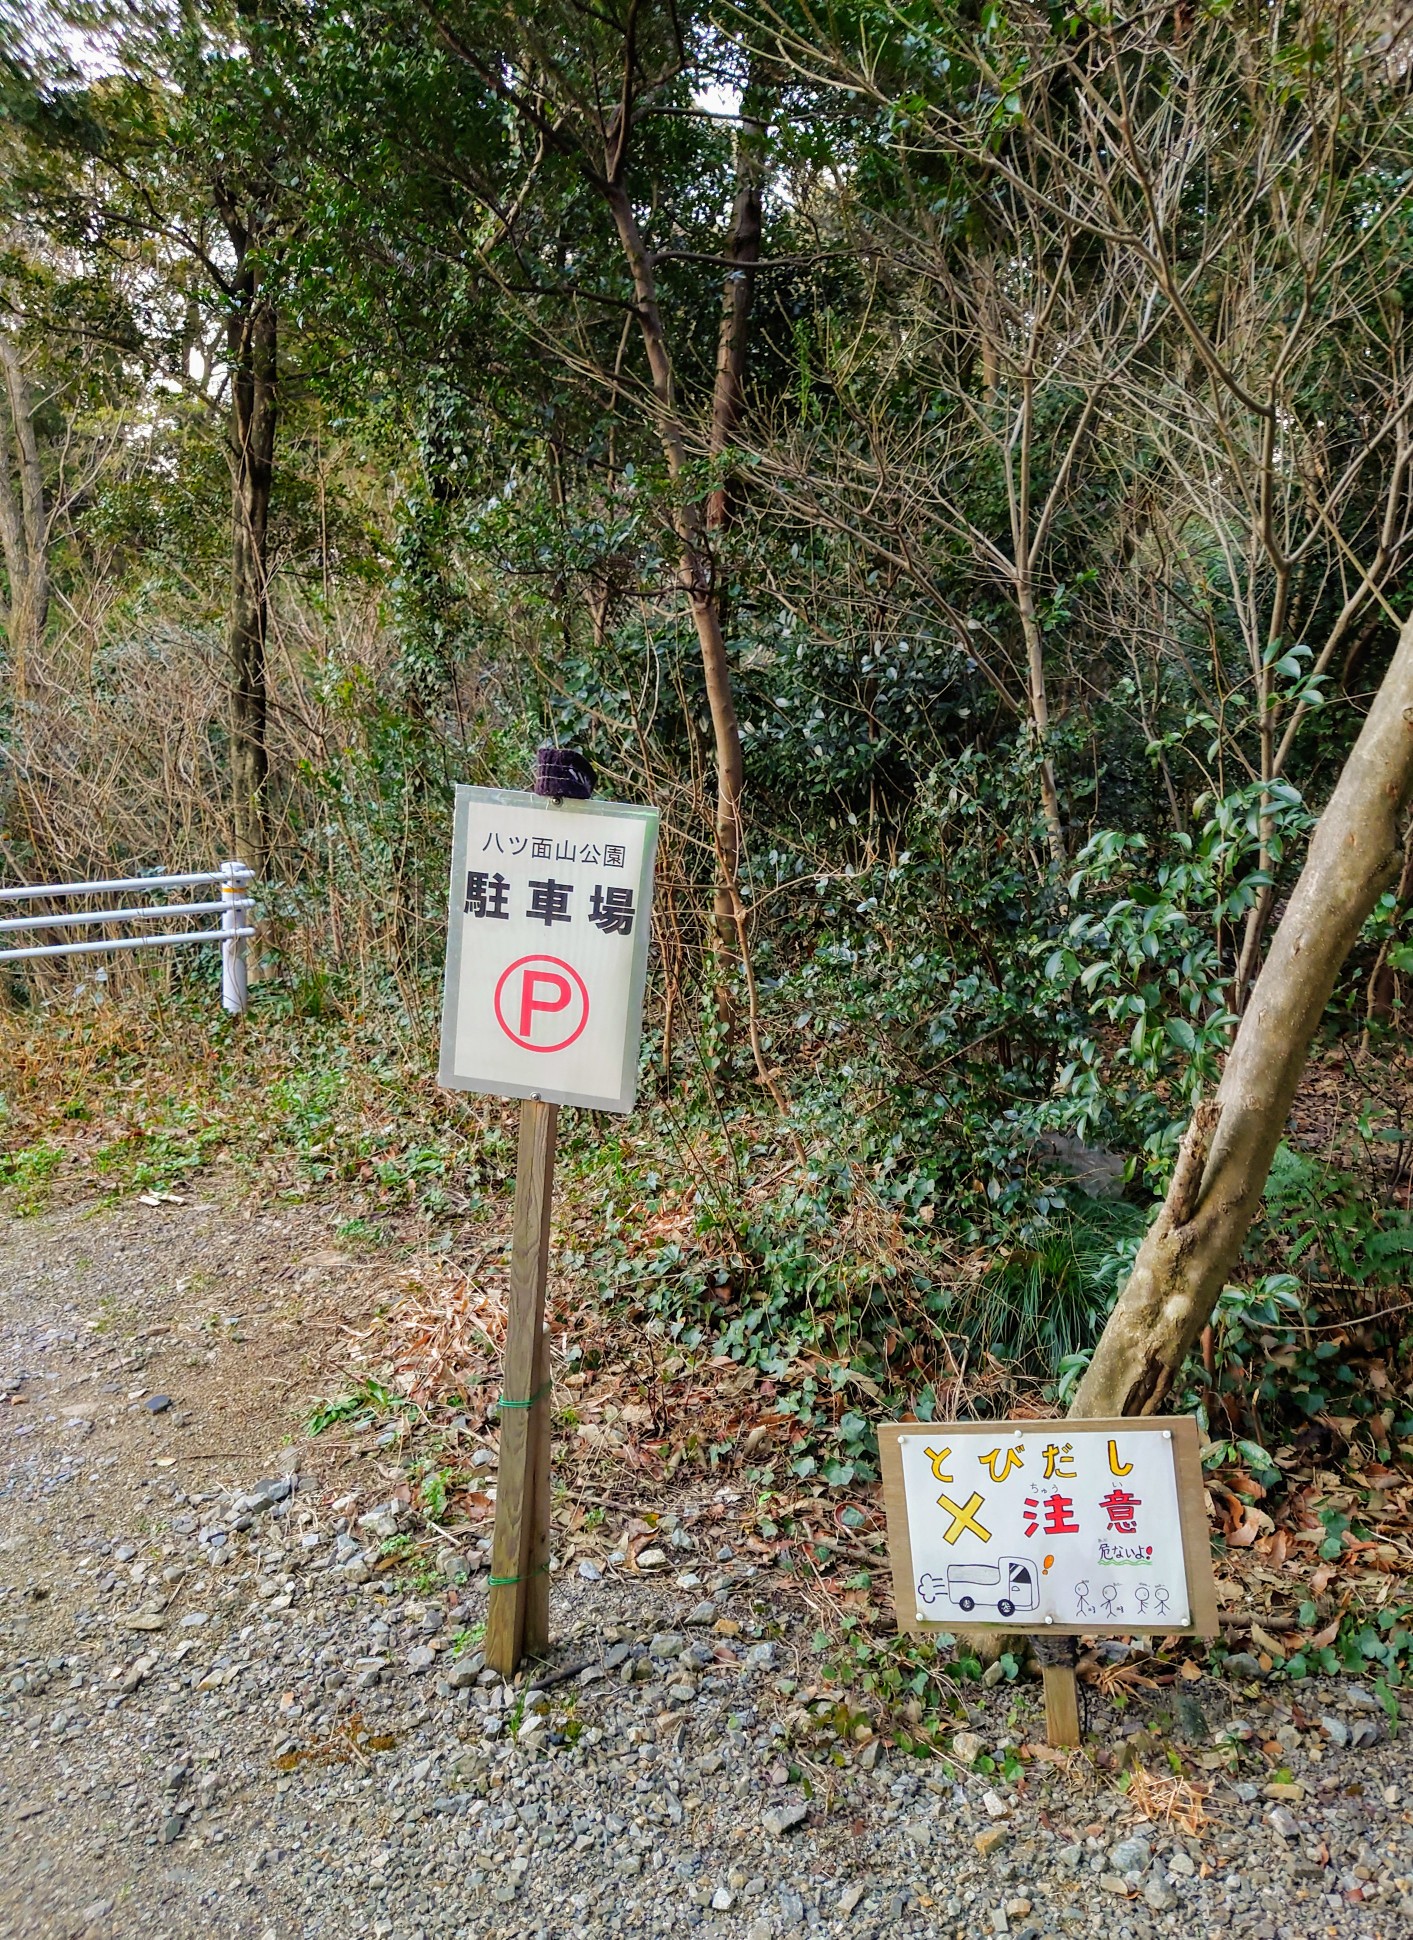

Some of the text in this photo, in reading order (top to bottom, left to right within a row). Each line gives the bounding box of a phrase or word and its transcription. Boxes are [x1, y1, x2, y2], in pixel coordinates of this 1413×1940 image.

[482, 831, 626, 869] 八ツ面山公園
[463, 870, 636, 936] 駐車場
[519, 969, 572, 1037] P
[923, 1439, 1134, 1483] とびだし
[1030, 1482, 1059, 1494] ちゅう
[1023, 1489, 1142, 1538] 注意
